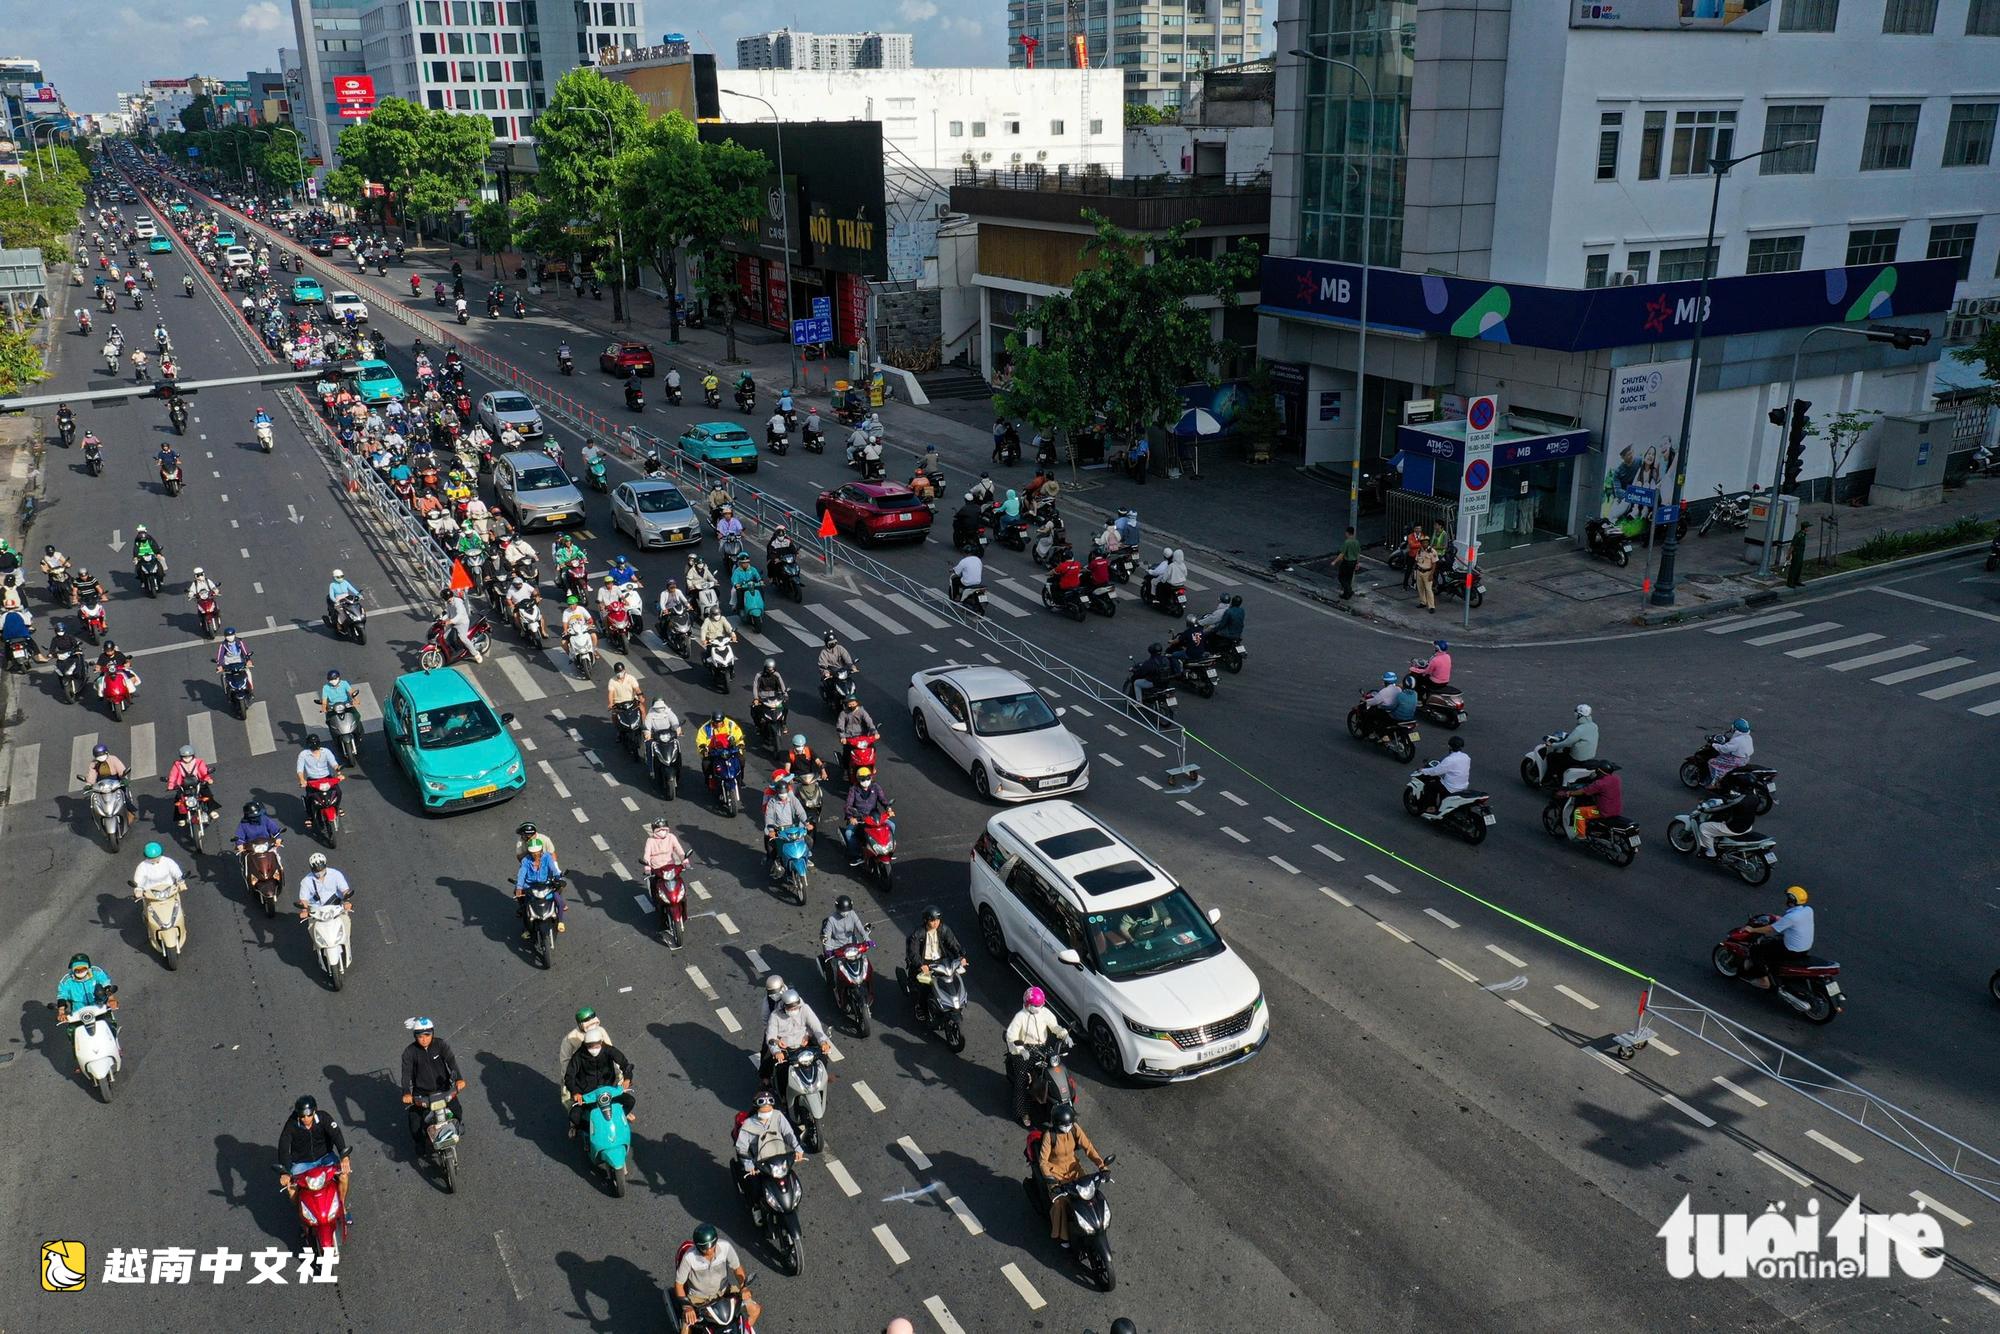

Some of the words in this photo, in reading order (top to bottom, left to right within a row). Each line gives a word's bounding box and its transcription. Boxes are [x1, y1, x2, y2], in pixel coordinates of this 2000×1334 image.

[809, 208, 832, 252] NỘI
[837, 205, 873, 250] THẤT
[1320, 277, 1351, 303] MB
[1674, 296, 1711, 325] MB
[1426, 439, 1442, 449] ATM
[1517, 446, 1531, 457] MB
[1546, 442, 1560, 450] ATM
